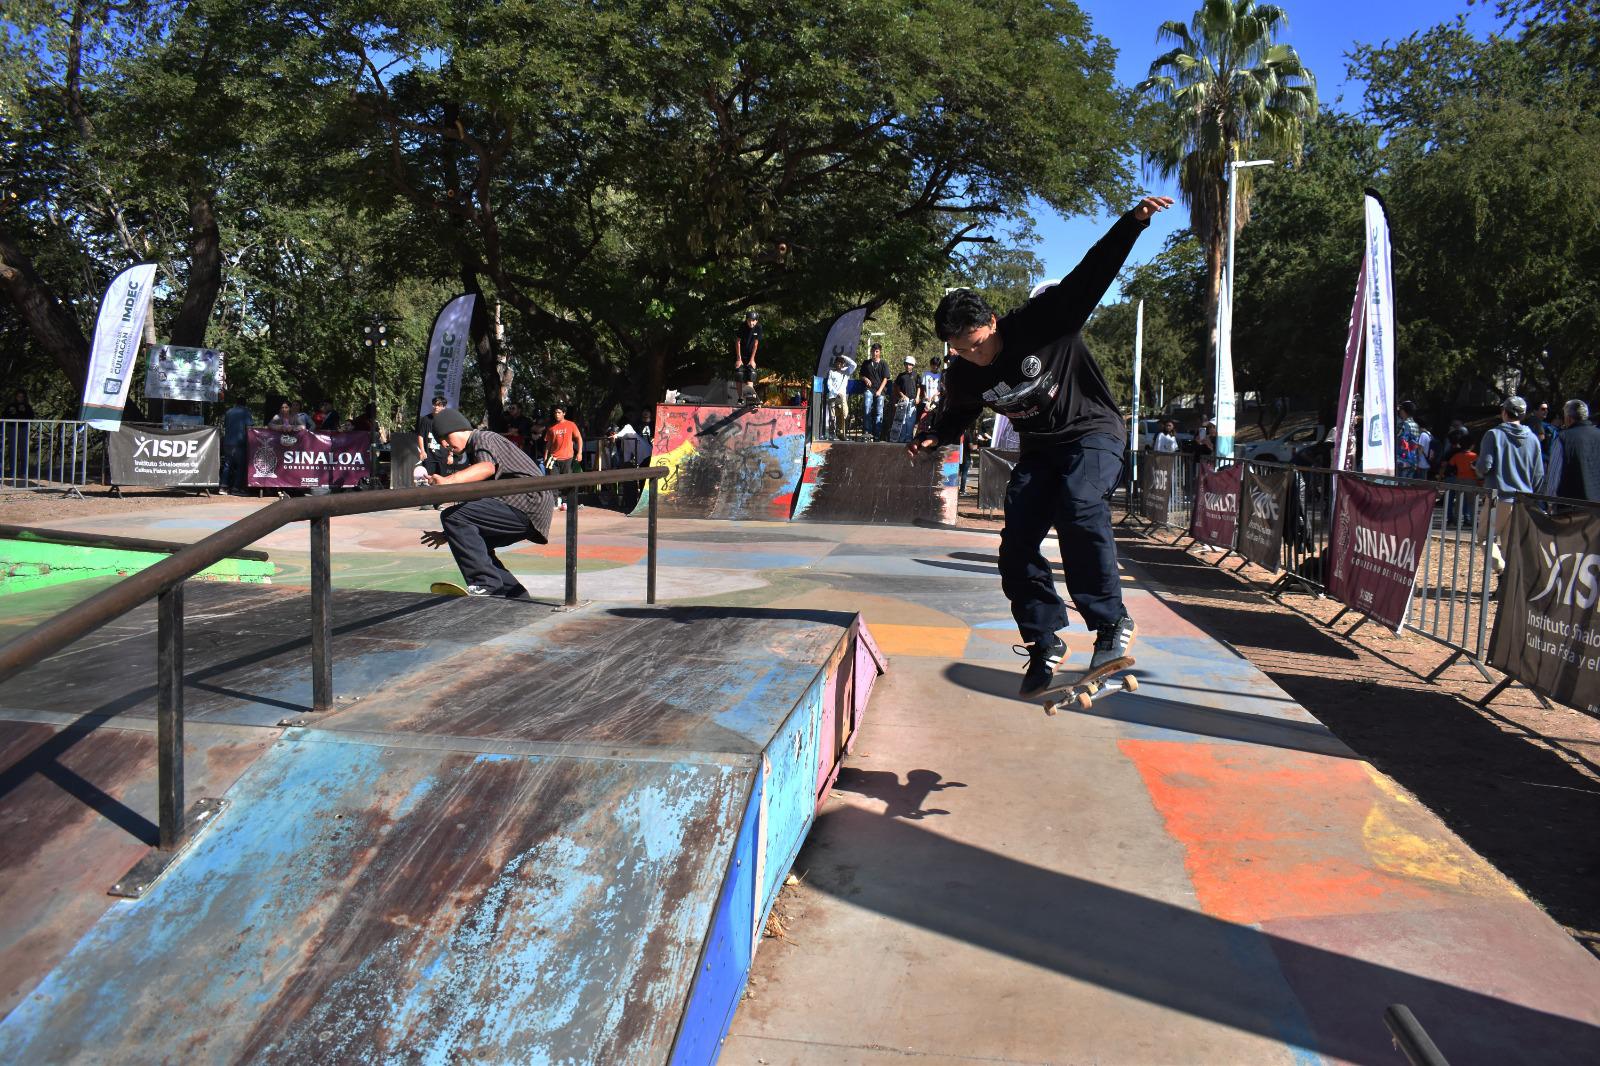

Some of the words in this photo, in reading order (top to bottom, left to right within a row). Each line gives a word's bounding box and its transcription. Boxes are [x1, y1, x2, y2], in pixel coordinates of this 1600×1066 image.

[122, 281, 139, 322] IMDEC
[433, 332, 456, 397] IMDEC
[153, 439, 198, 458] ISDE
[283, 450, 365, 465] SINALOA
[1354, 525, 1417, 573] SINALOA
[1563, 552, 1600, 613] IS
[1527, 610, 1570, 637] Instituto
